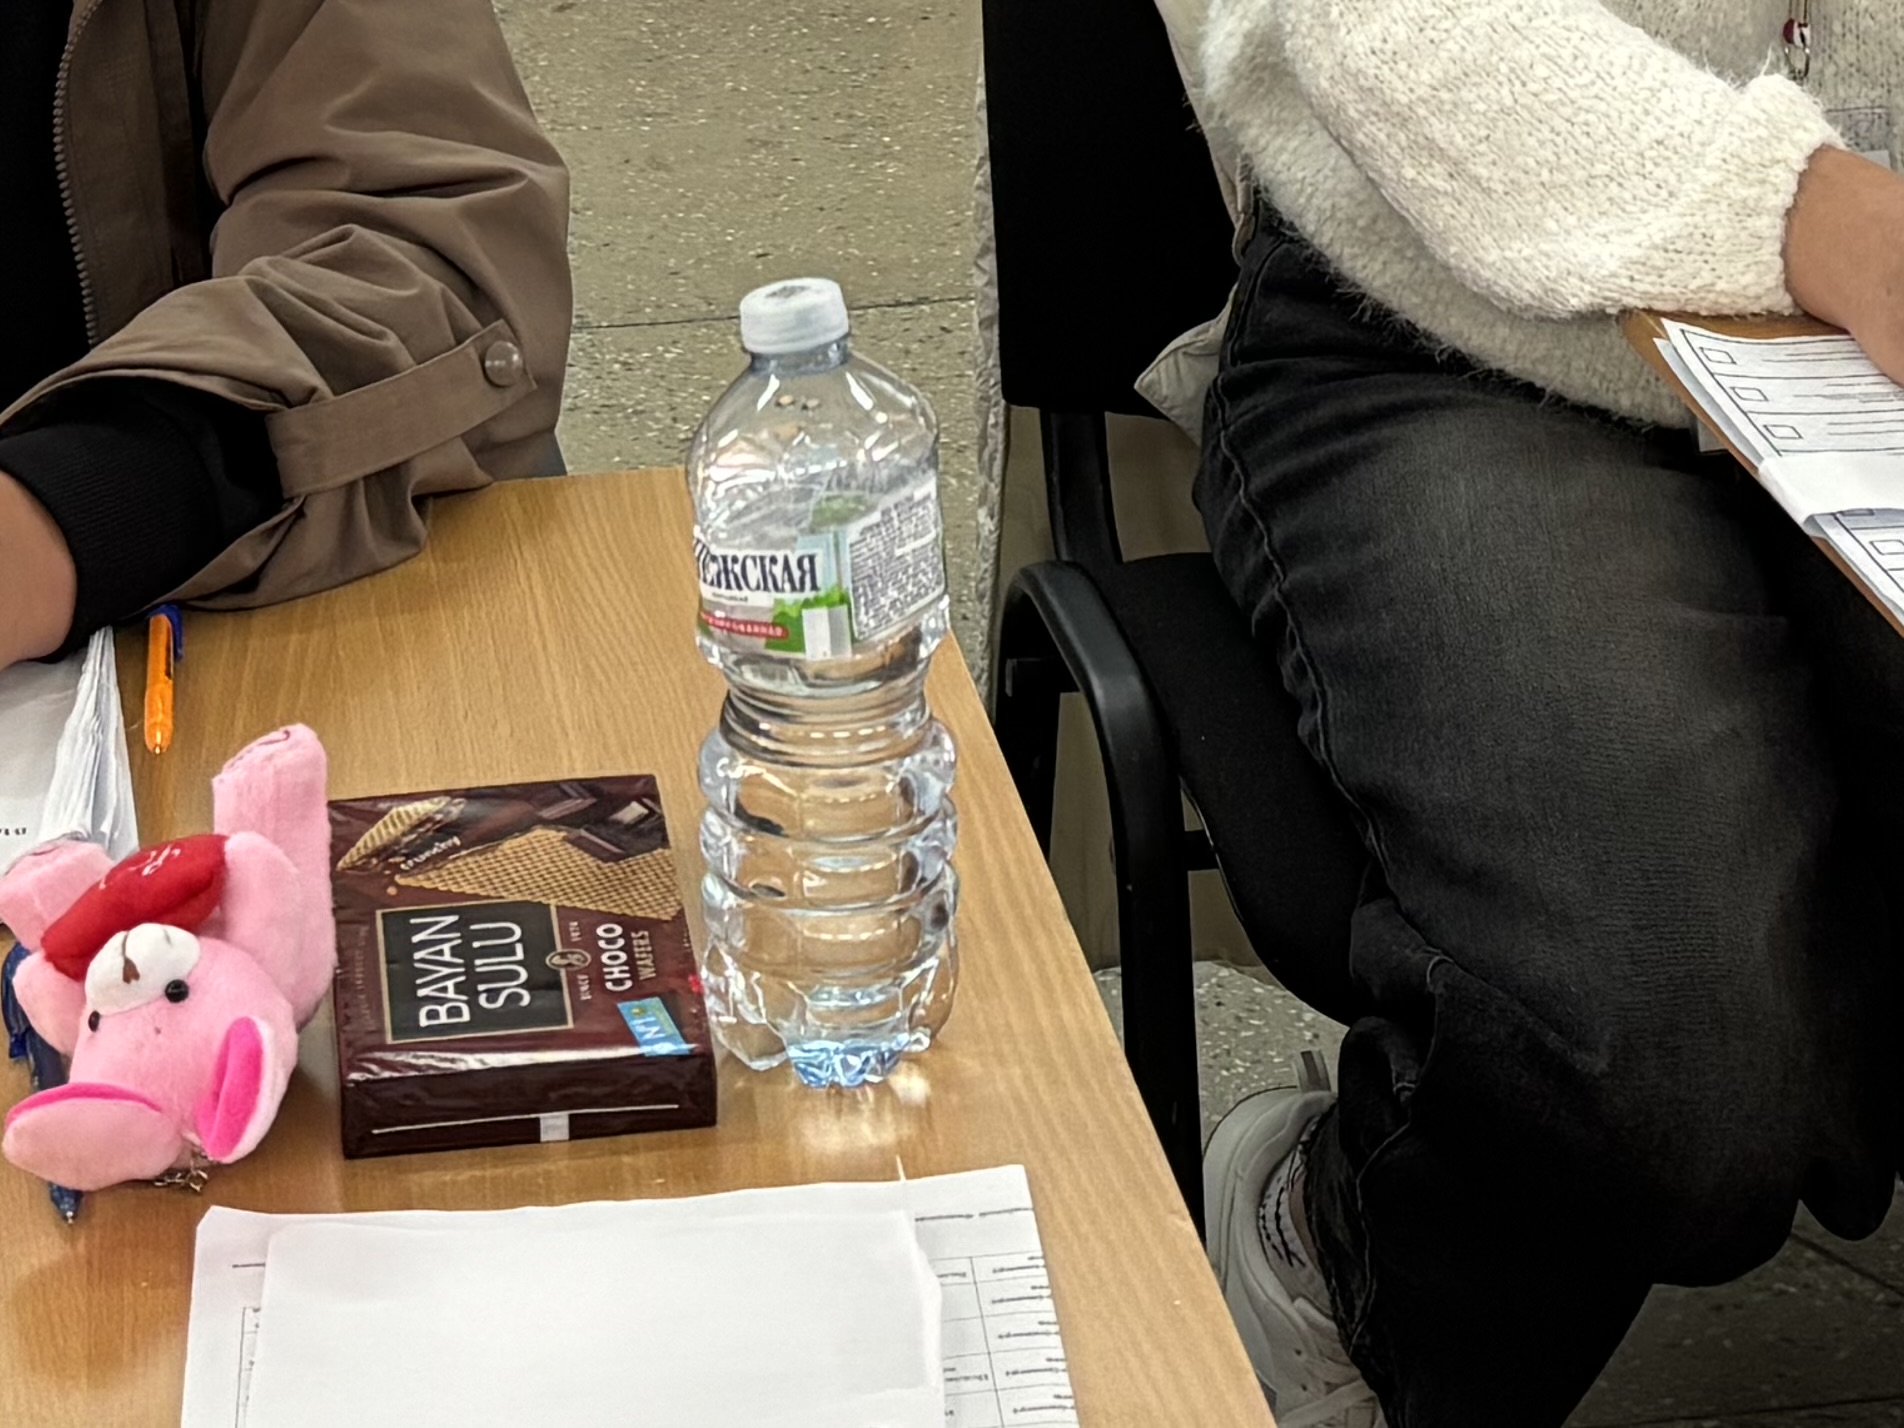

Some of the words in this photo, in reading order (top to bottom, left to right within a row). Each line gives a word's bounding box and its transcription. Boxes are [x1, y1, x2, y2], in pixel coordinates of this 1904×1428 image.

[410, 914, 471, 1028] BAYAN
[470, 921, 531, 1011] SULU
[596, 922, 633, 993] CHOCO
[632, 929, 659, 981] WAFERS
